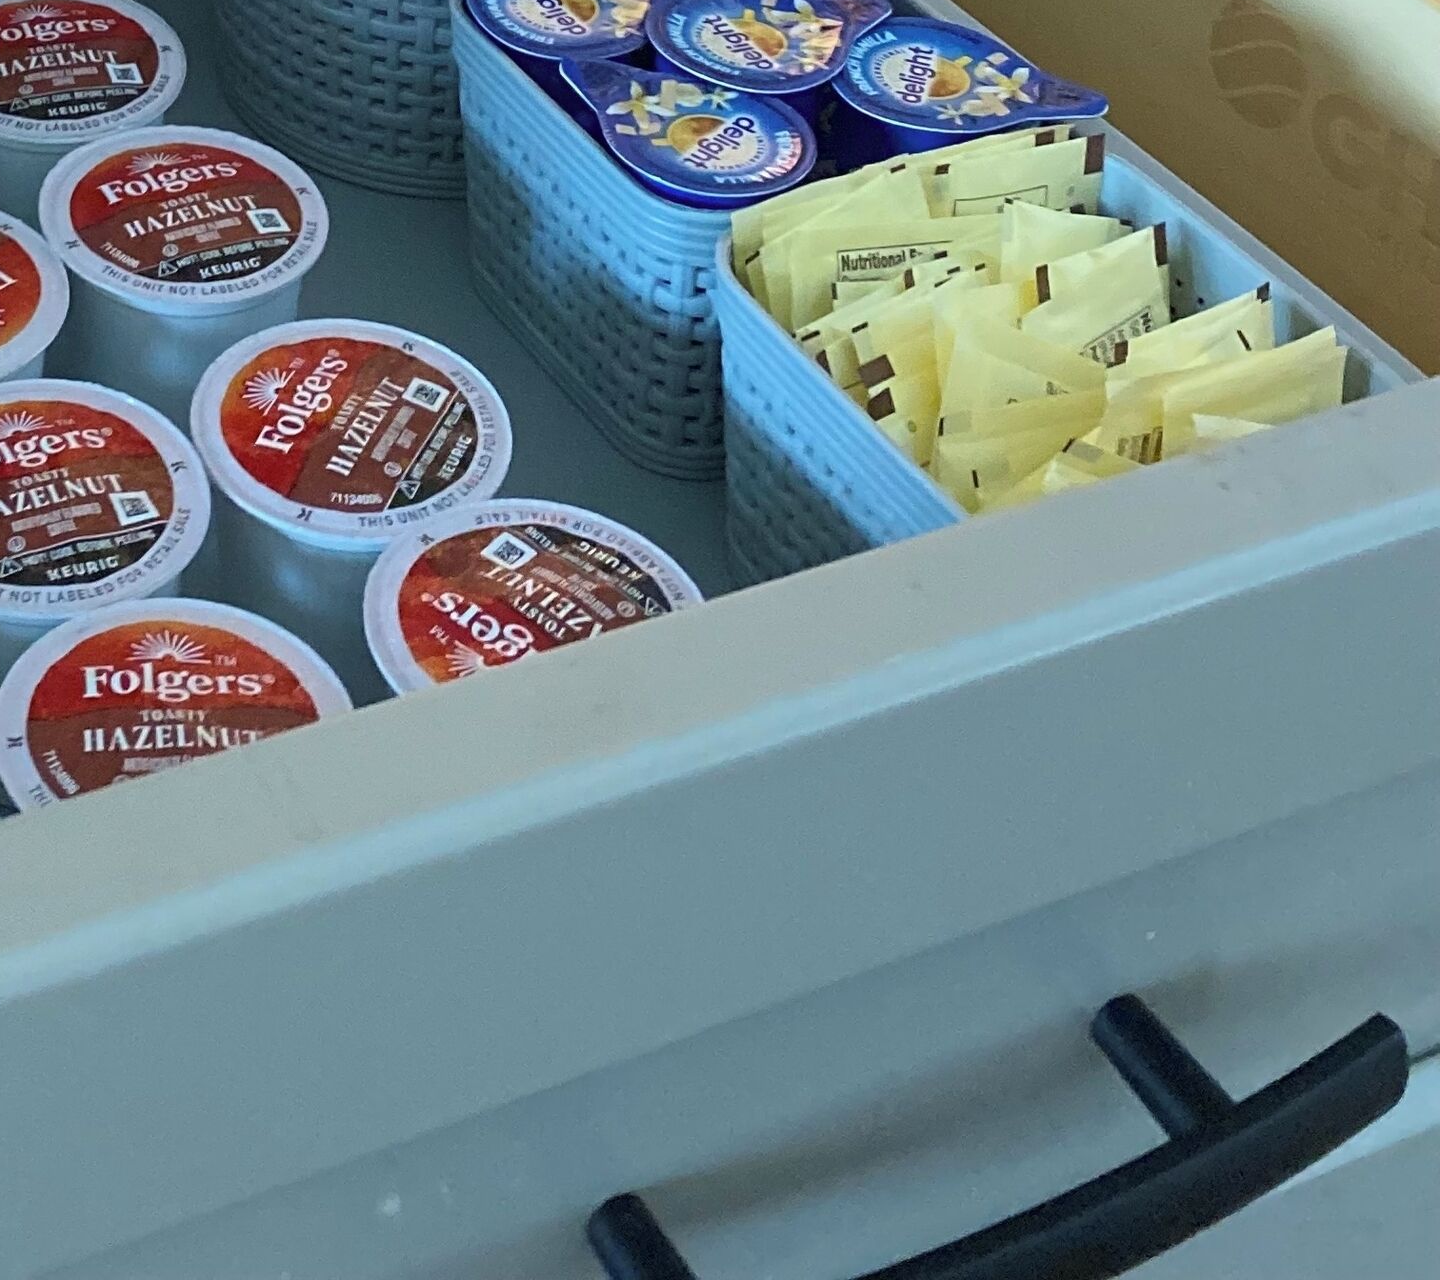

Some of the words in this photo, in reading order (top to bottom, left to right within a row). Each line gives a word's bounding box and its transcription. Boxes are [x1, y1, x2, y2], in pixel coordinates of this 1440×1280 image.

[28, 43, 76, 54] TOASTY
[704, 15, 774, 70] delight
[895, 45, 934, 104] delight
[15, 120, 41, 131] NOT
[45, 120, 101, 132] LABELED
[103, 110, 126, 125] FOR
[48, 102, 108, 117] KEURIG
[683, 116, 755, 170] delight
[97, 161, 238, 206] Folgers
[159, 192, 209, 210] TOASTY
[123, 194, 257, 238] HAZELNUT
[100, 264, 128, 283] THIS
[132, 279, 164, 293] UNIT
[169, 285, 197, 296] NOT
[201, 277, 260, 296] LABELED
[262, 264, 286, 282] FOR
[199, 257, 261, 279] KEURIG
[841, 250, 906, 272] Nutritional
[254, 355, 350, 456] Folgers
[325, 376, 406, 478] HAZELNUT
[10, 467, 70, 491] TOASTY
[358, 514, 394, 528] THIS
[396, 506, 431, 526] UNIT
[432, 491, 461, 514] NOT
[459, 455, 493, 497] LABELED
[46, 556, 121, 582] KEURIG
[576, 539, 646, 582] KEURIG
[9, 589, 42, 603] NOT
[46, 581, 116, 604] LABELED
[116, 565, 145, 588] FOR
[480, 566, 604, 639] ZELNUT
[433, 590, 534, 659] gers
[512, 595, 567, 639] TOASTY
[81, 662, 262, 703] Folgers
[139, 709, 208, 722] TOASTY
